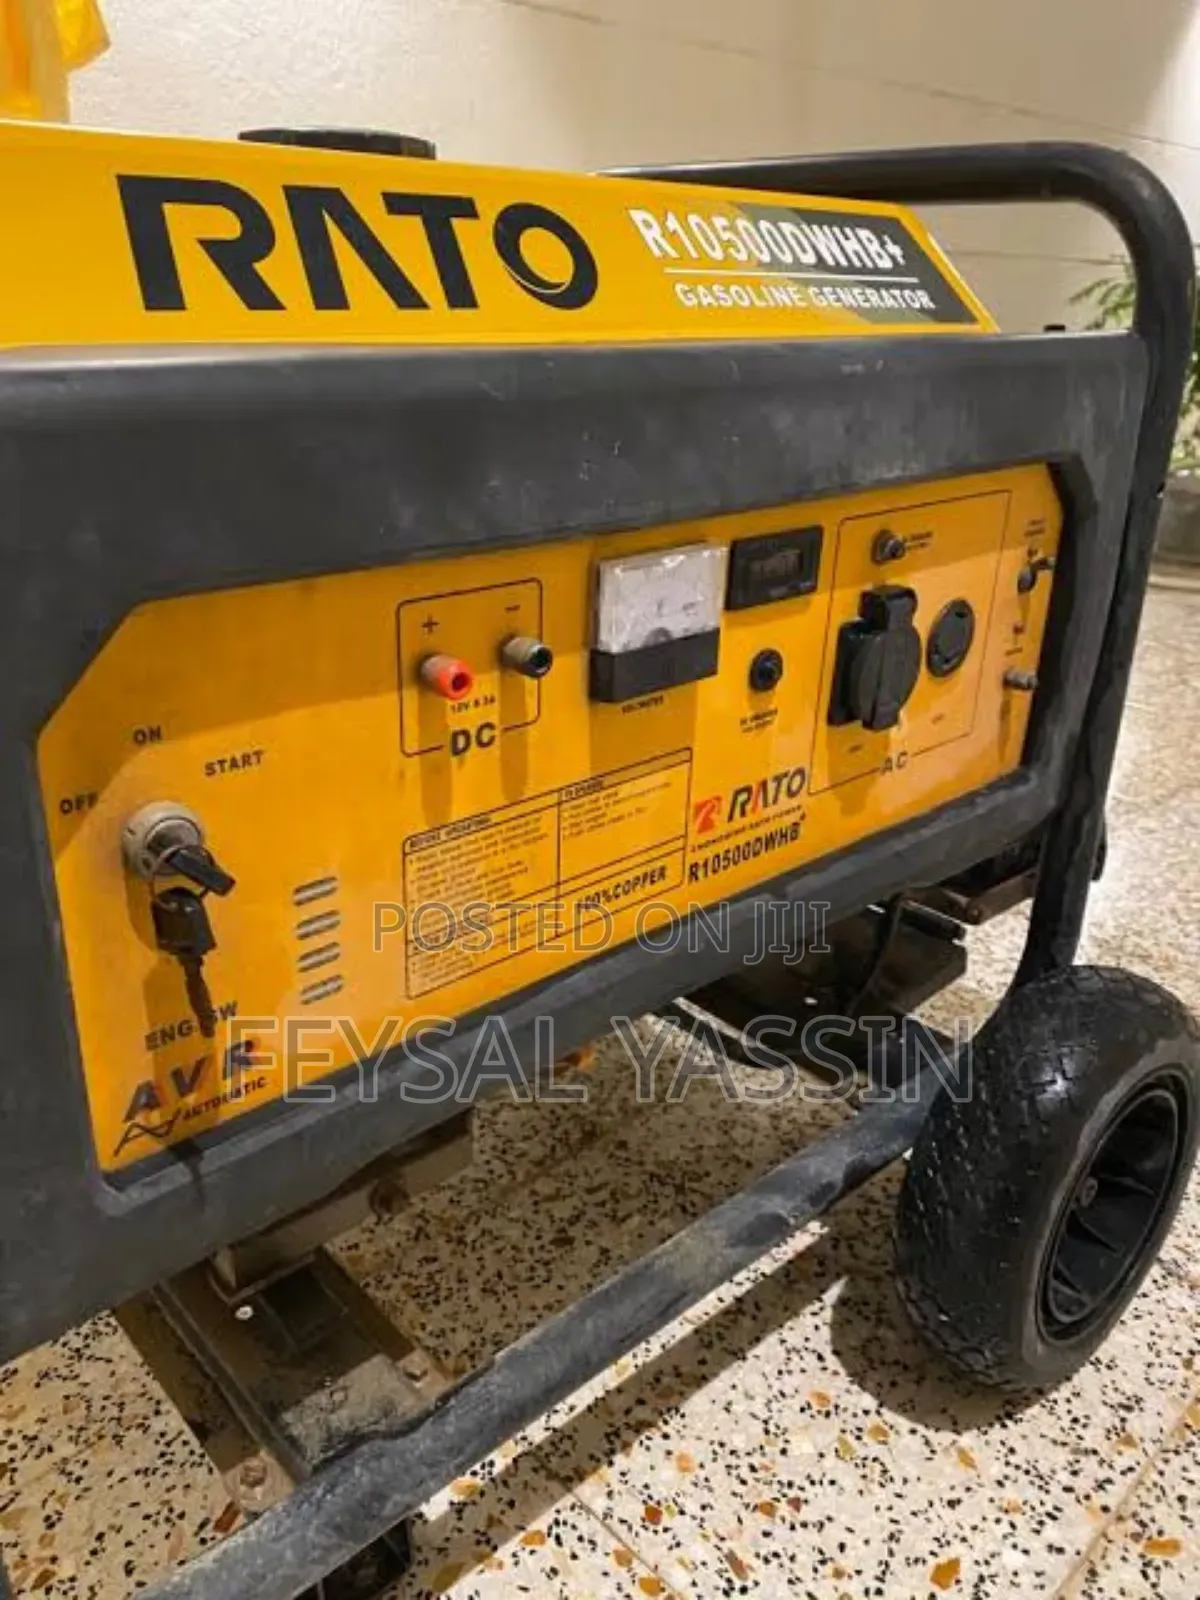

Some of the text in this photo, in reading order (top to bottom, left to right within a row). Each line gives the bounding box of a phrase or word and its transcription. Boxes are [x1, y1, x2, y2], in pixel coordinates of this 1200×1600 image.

[116, 174, 599, 311] RATO
[630, 209, 906, 269] R10500DWHB+
[674, 281, 936, 311] GASOLINE GENERATOR
[133, 725, 162, 745] ON
[450, 722, 497, 757] DC
[204, 749, 264, 776] START
[59, 792, 98, 815] OFF
[727, 766, 806, 824] RATO
